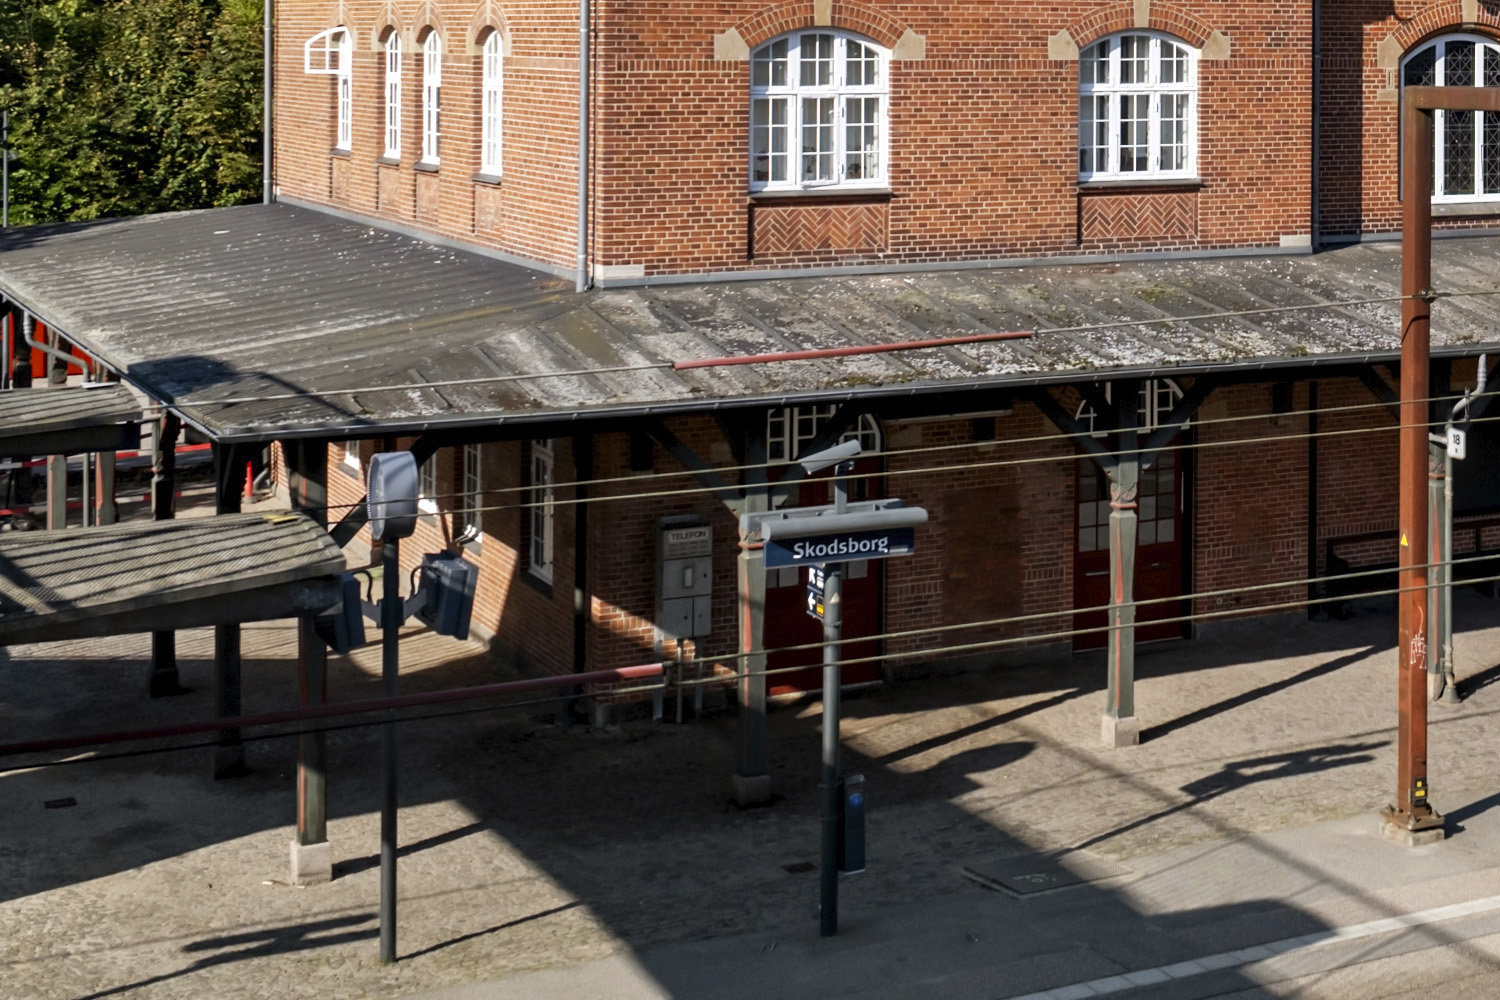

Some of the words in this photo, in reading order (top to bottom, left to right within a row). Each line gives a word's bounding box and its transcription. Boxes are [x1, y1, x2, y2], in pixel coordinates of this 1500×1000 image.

[1453, 434, 1460, 445] 18
[672, 530, 707, 540] TELEFON
[793, 537, 888, 558] Skodsborg
